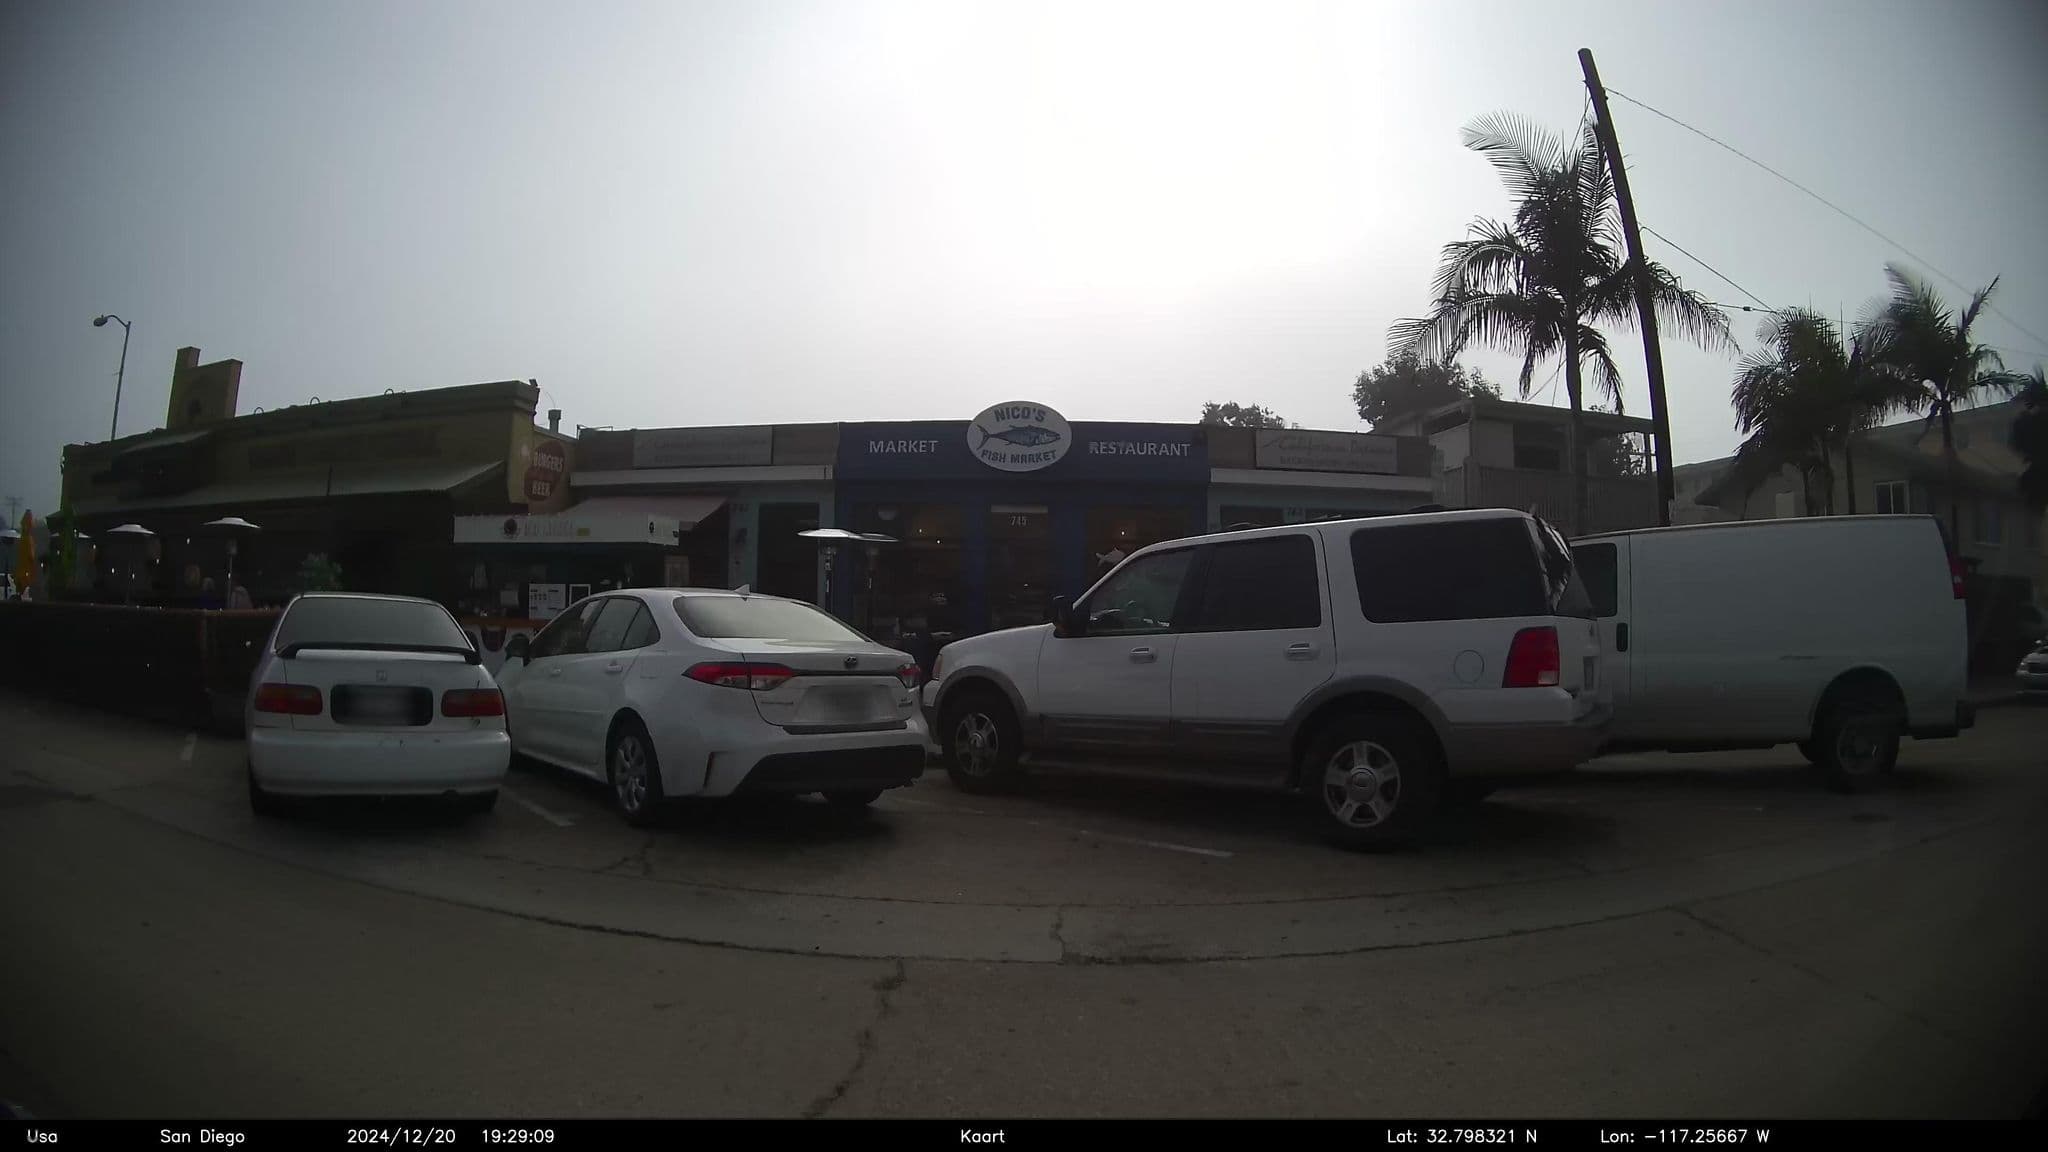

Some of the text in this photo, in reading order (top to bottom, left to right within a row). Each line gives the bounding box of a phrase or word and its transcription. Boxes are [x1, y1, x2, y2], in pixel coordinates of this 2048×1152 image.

[994, 406, 1046, 422] NICO'S
[869, 440, 938, 454] MARKET
[1089, 441, 1192, 457] RESTAURANT
[980, 449, 1058, 465] FISH MARKET
[531, 480, 552, 497] BEER
